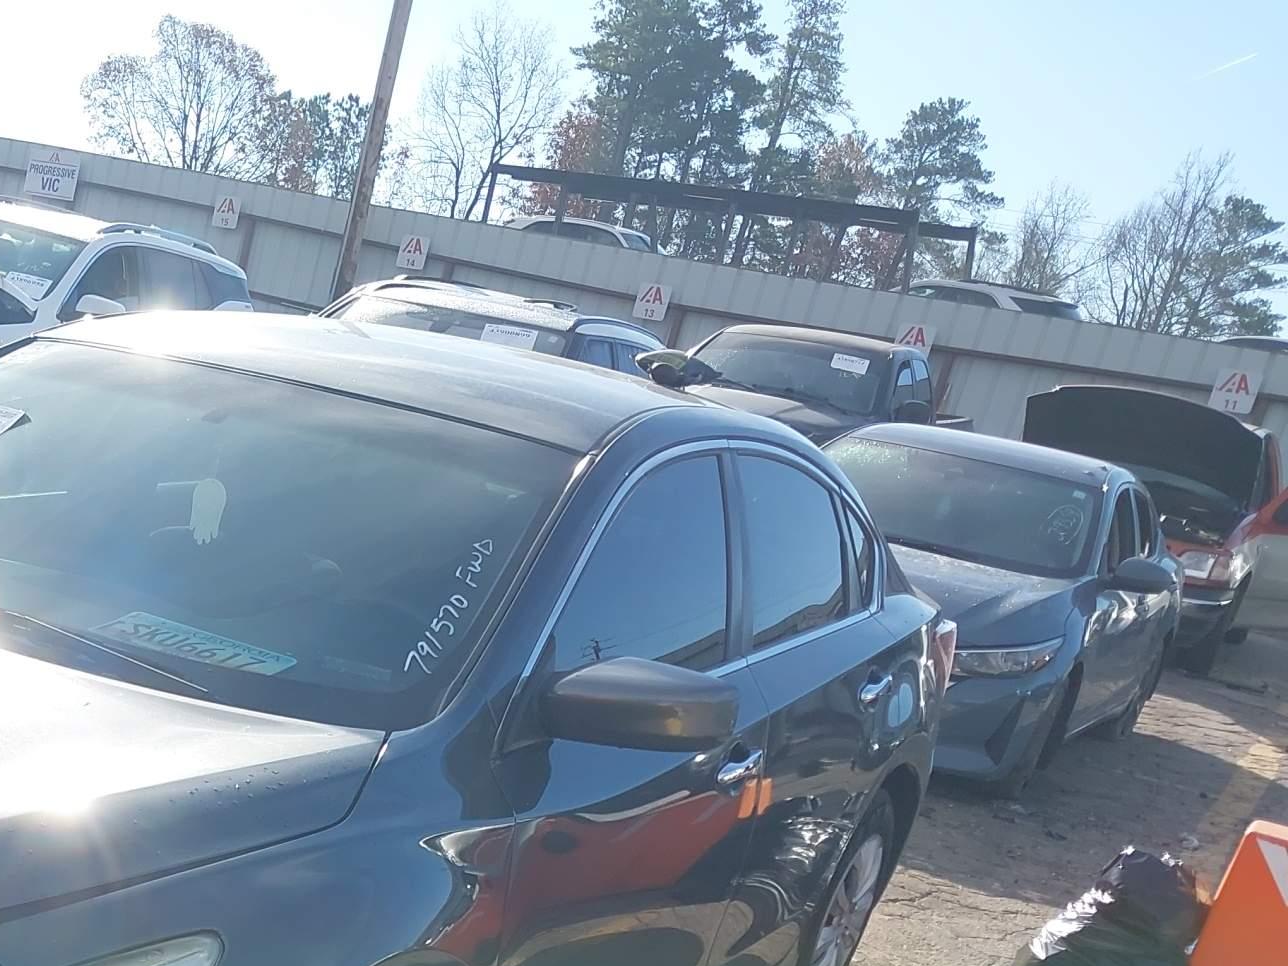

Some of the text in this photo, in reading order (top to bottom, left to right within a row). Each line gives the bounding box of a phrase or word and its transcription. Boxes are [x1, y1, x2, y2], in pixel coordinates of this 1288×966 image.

[29, 163, 77, 179] PROGRESSIVE
[41, 176, 60, 193] VIC
[644, 308, 655, 318] 13
[1223, 399, 1238, 411] 11
[404, 538, 493, 674] 791570 FWD
[122, 622, 267, 669] SKU6617
